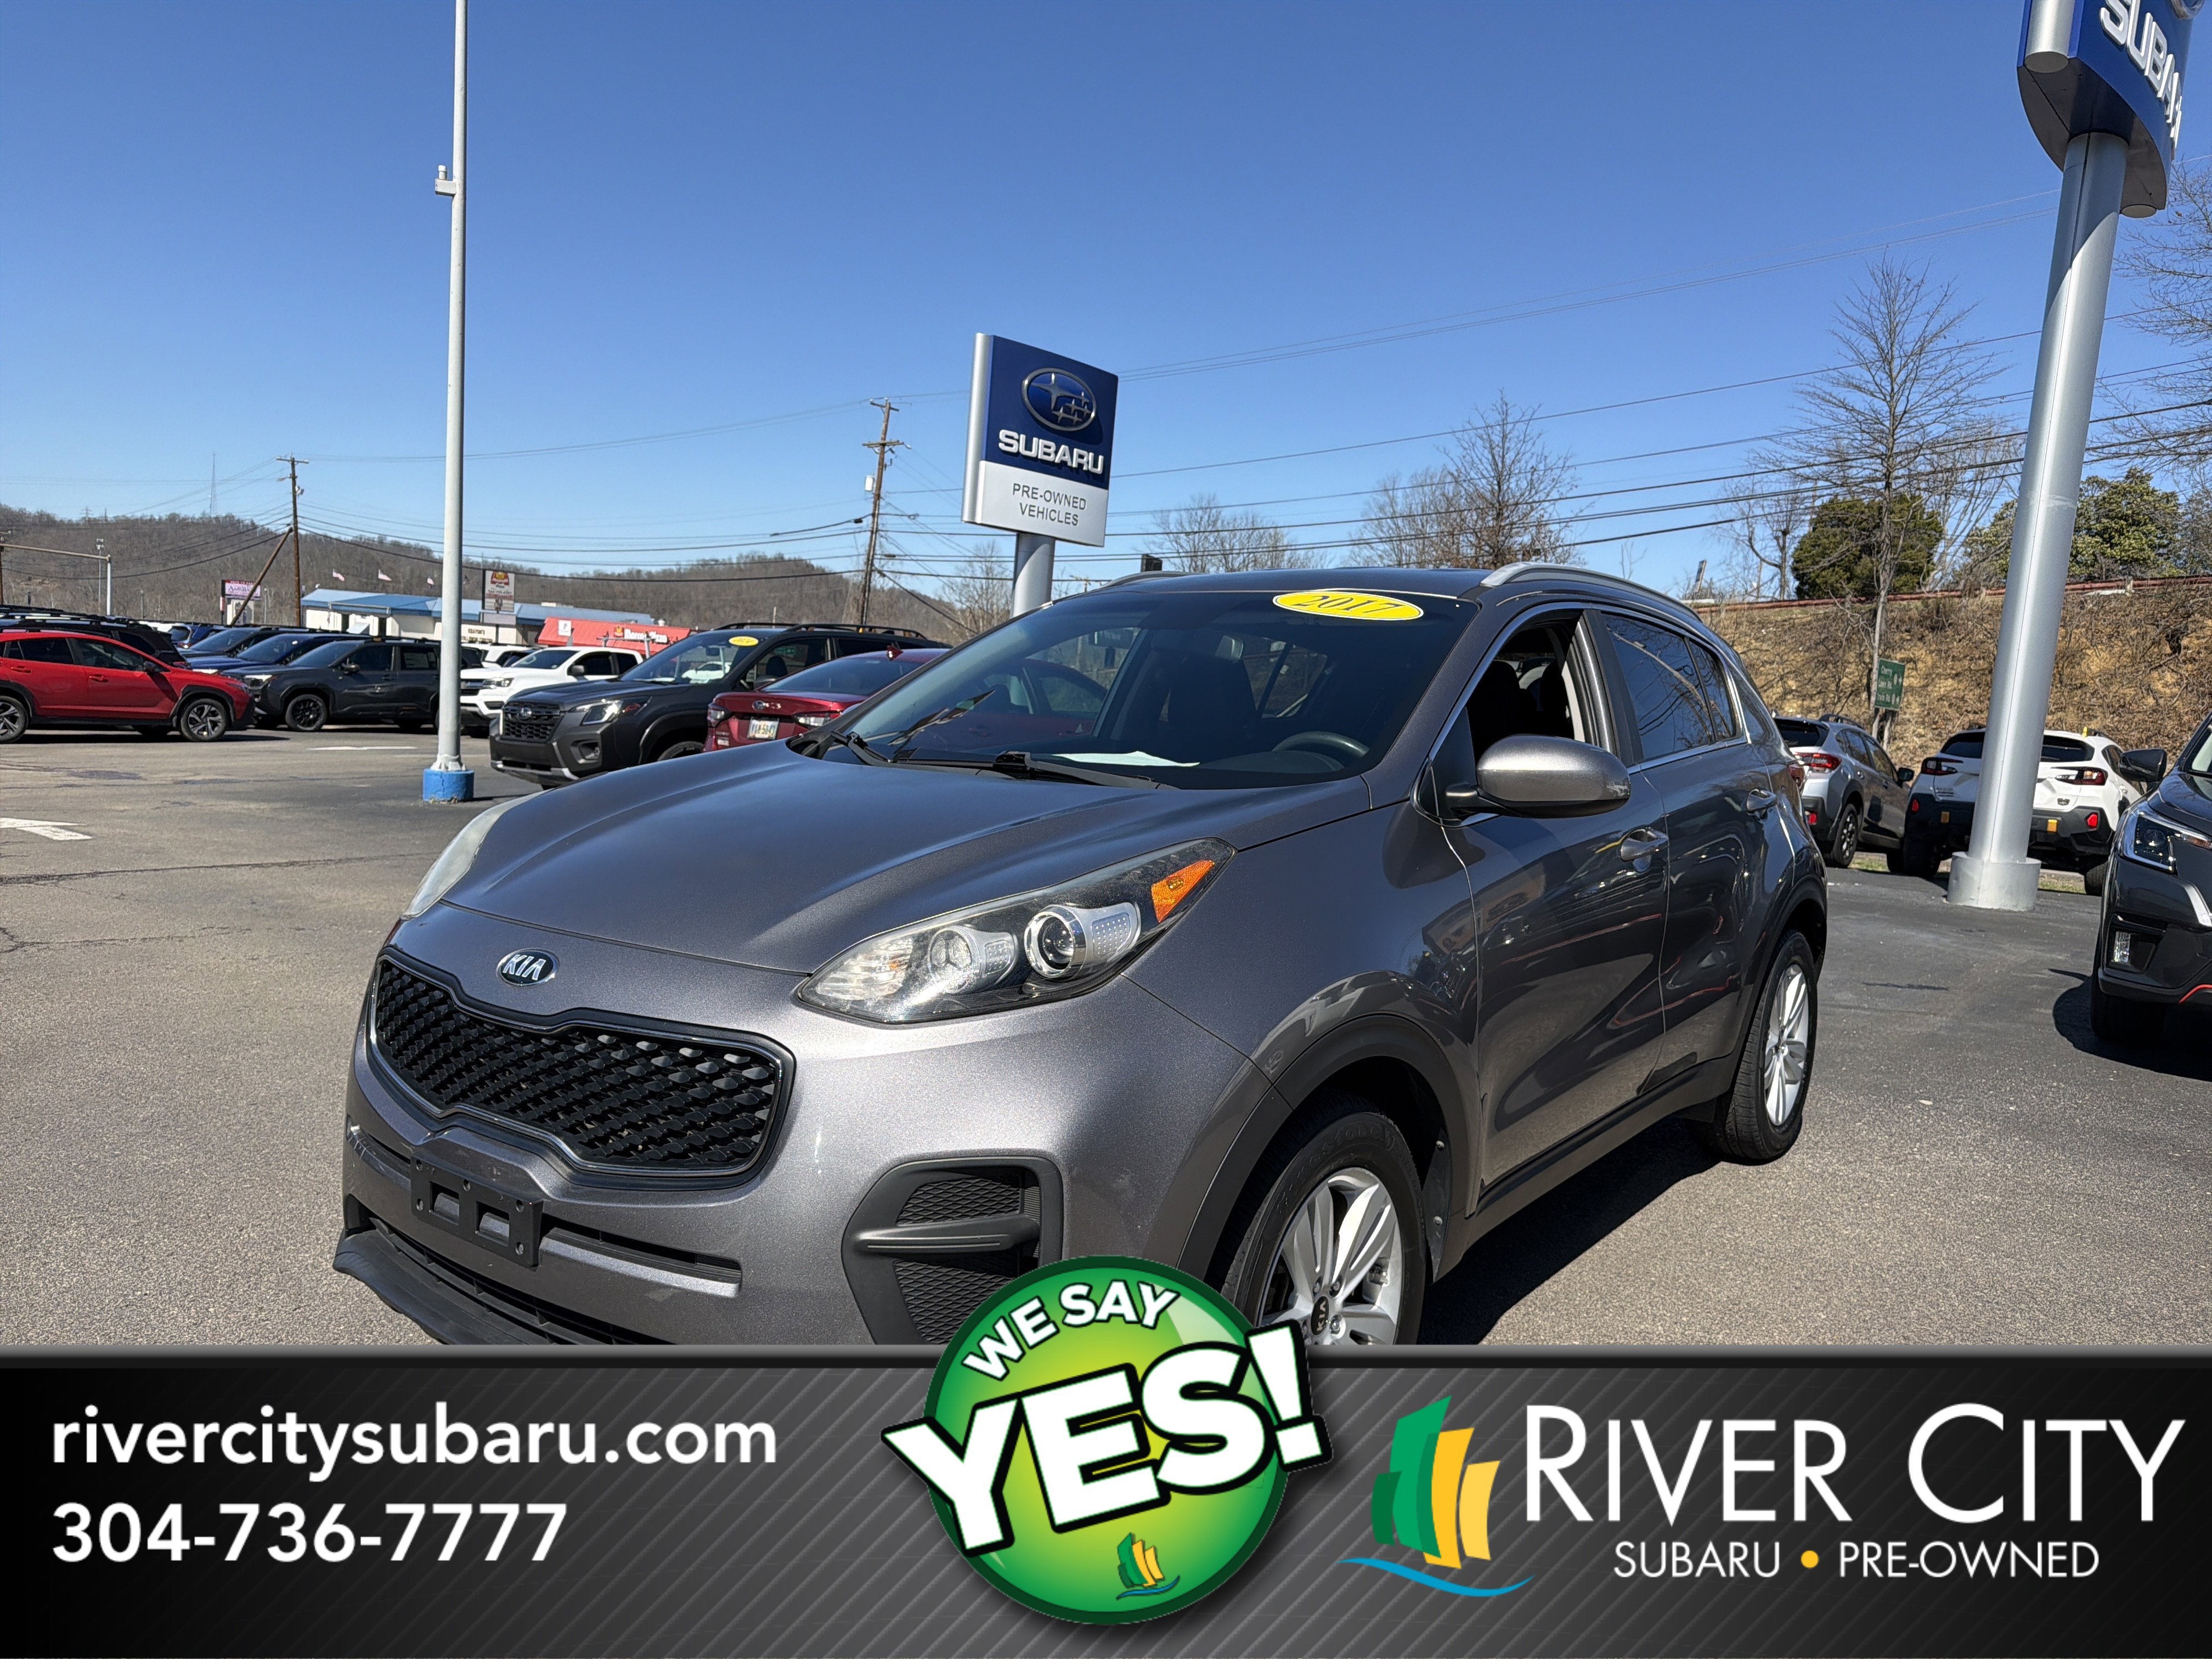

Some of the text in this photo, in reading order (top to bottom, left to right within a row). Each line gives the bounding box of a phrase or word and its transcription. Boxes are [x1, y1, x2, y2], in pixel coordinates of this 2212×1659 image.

[998, 429, 1104, 475] SUBARU
[1012, 482, 1086, 511] PRE-OWNED
[1019, 502, 1079, 526] VEHICLES
[1291, 595, 1403, 613] 2017
[502, 954, 547, 981] KIA
[1316, 1300, 1327, 1331] KIA
